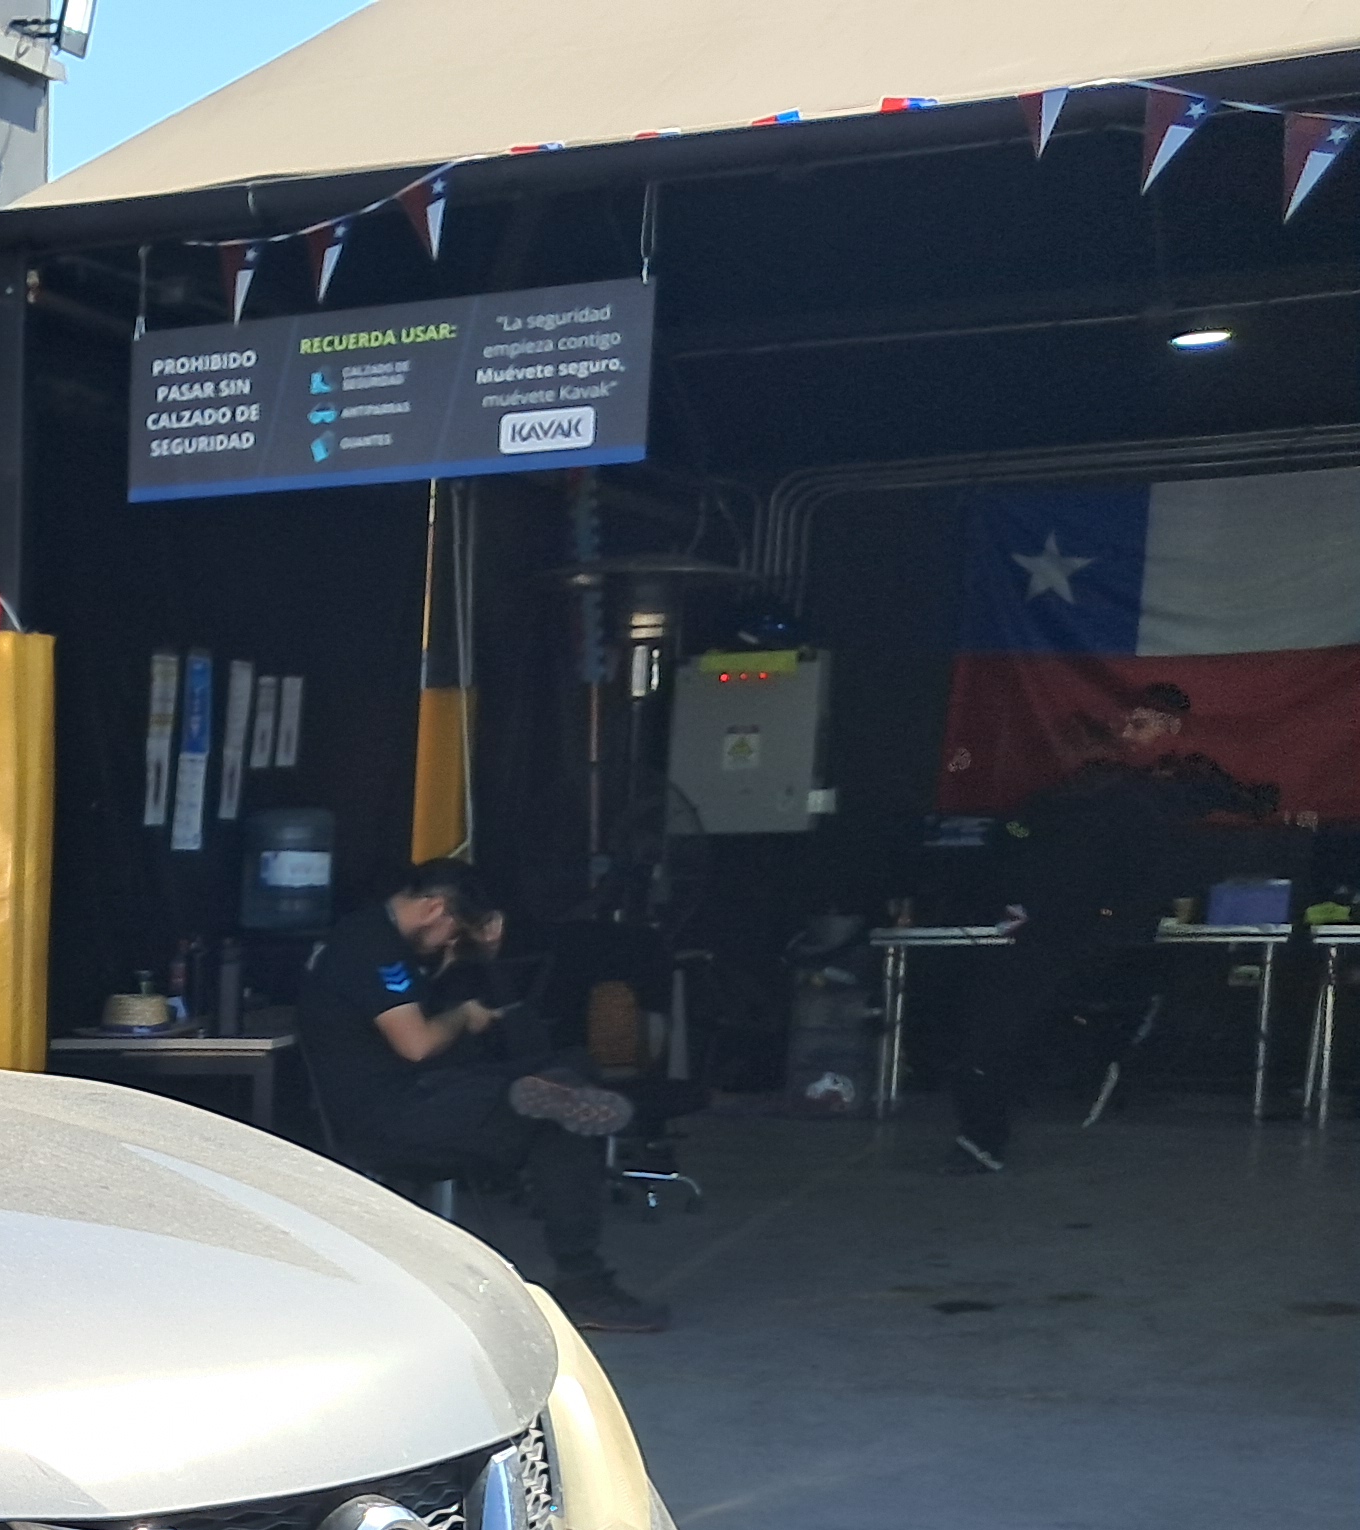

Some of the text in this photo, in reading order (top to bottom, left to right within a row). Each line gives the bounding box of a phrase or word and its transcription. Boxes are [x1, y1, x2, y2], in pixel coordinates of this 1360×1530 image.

[527, 304, 612, 330] seguridad
[300, 323, 457, 354] RECUERDA USAR:
[483, 331, 621, 359] empieza contigo
[152, 350, 257, 377] PROHIBIDO
[476, 364, 554, 385] Muévete
[157, 378, 252, 402] PASAR SIN
[482, 389, 555, 408] muévete
[146, 403, 260, 430] CALZADO DE
[510, 418, 582, 443] KAVAK
[150, 431, 255, 457] SEGURIDAD
